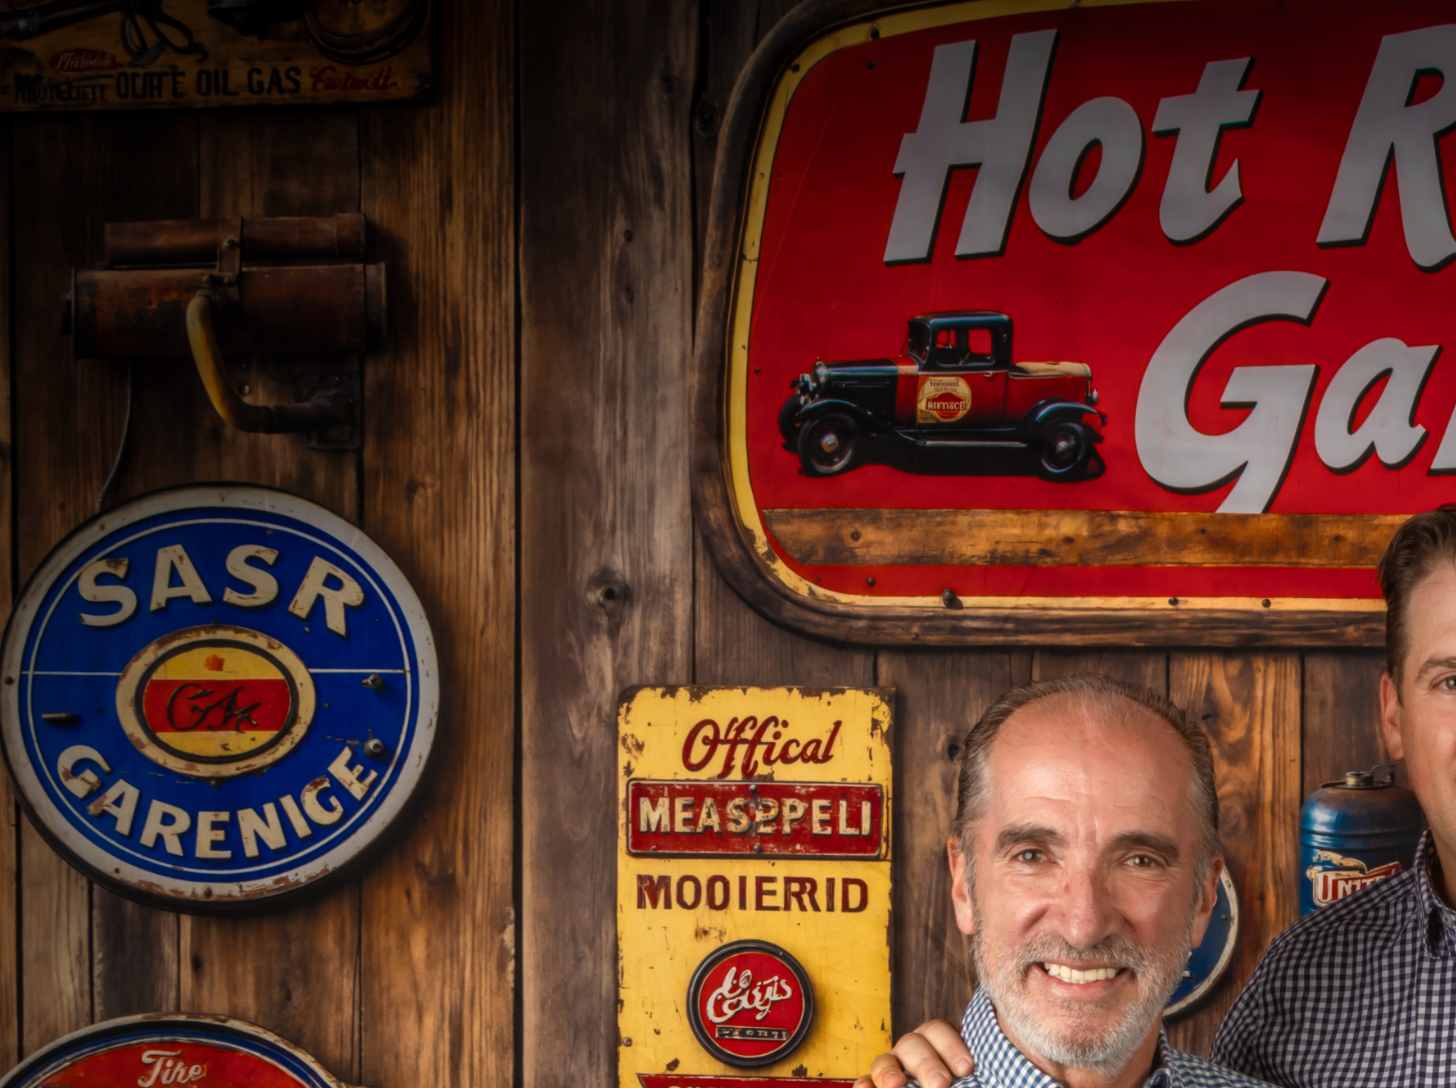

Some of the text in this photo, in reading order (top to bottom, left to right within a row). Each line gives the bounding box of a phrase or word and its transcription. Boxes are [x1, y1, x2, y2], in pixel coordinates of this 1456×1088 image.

[247, 66, 301, 96] GAS
[883, 28, 1261, 265] Hot
[78, 544, 365, 637] SASR
